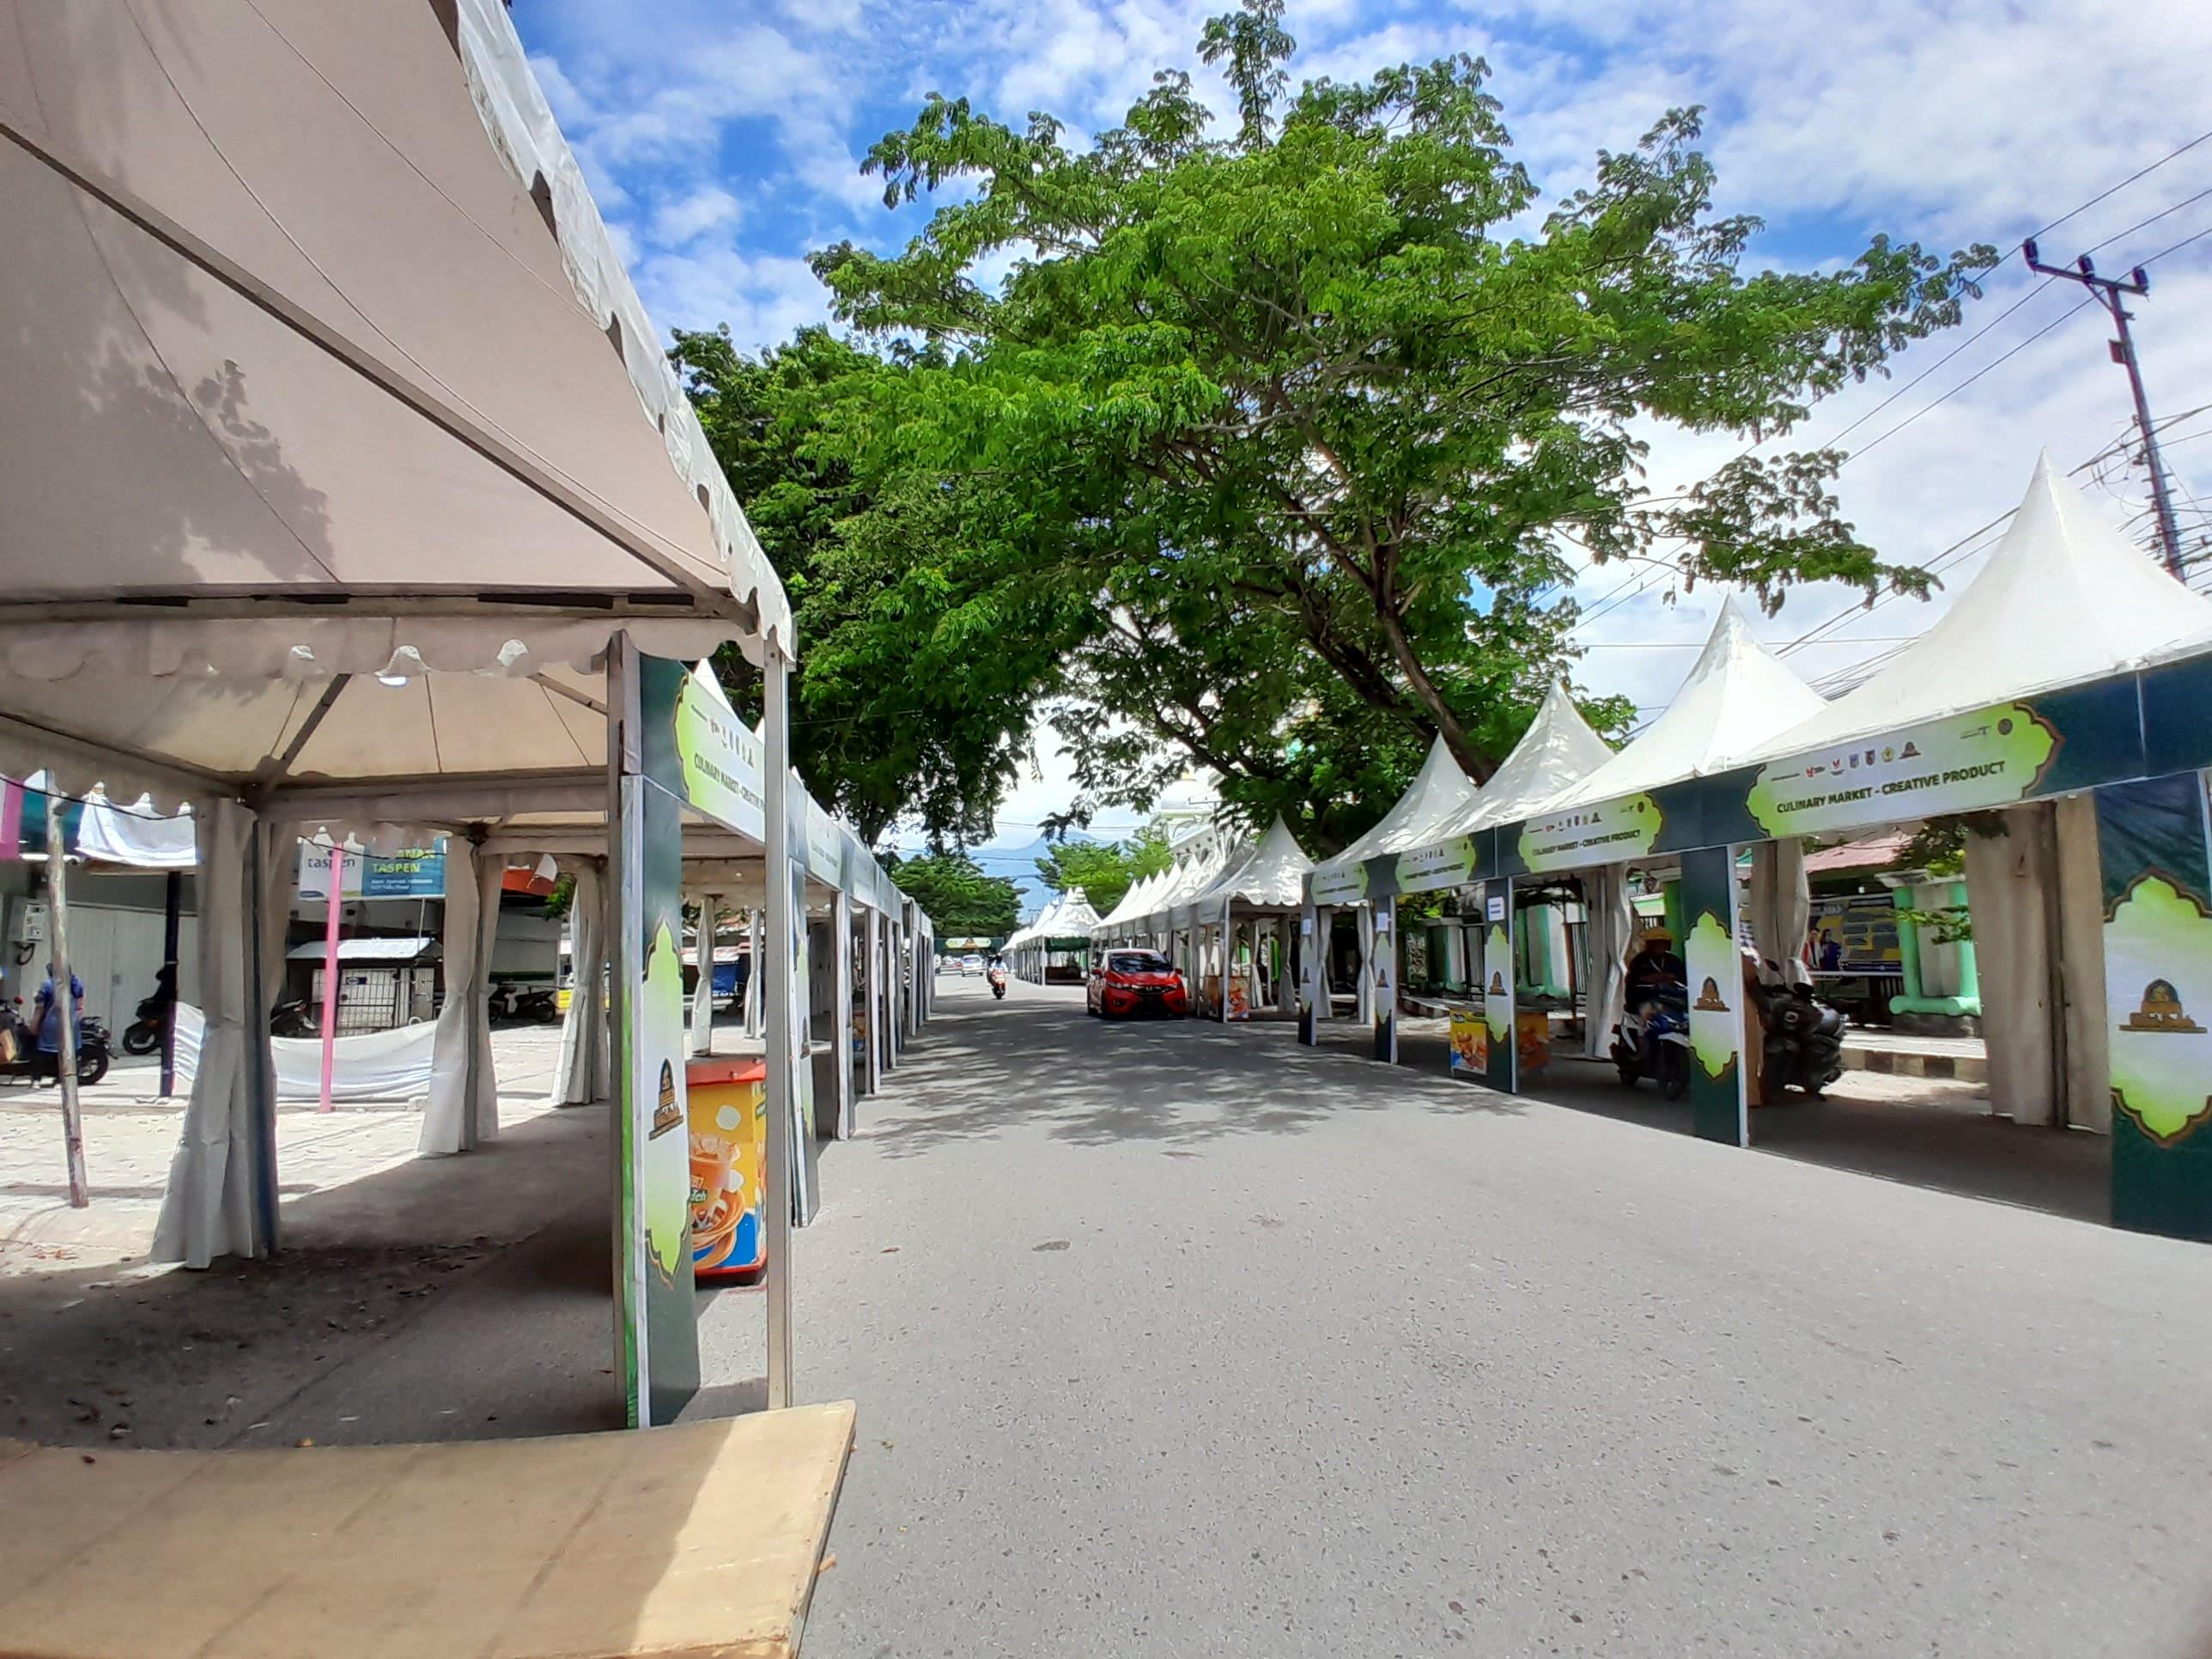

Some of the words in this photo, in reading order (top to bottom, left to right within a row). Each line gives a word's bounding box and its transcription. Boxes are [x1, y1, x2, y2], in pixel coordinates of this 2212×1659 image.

[1777, 796, 1826, 813] CULINARY
[1828, 787, 1872, 805] MARKET
[1881, 775, 1941, 795] CREATIVE
[1942, 761, 2006, 783] PRODUCT
[373, 862, 420, 873] TASPEN
